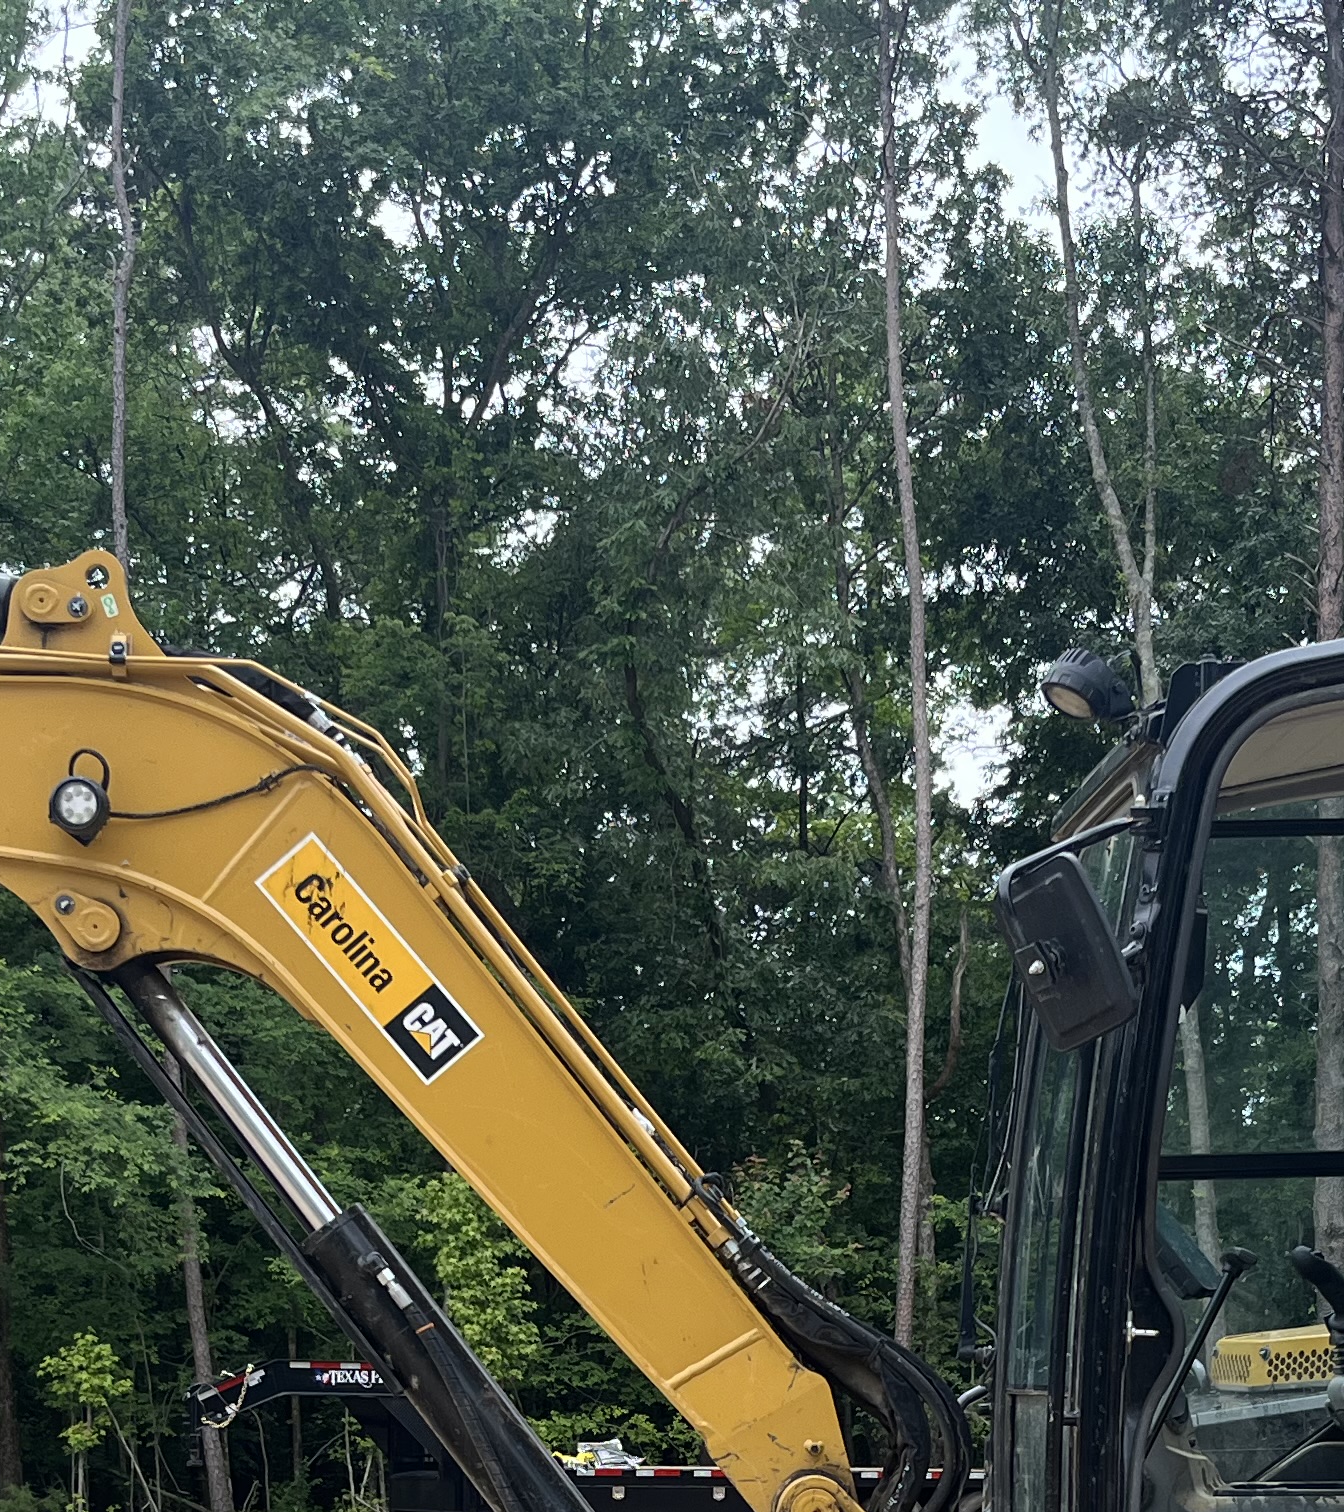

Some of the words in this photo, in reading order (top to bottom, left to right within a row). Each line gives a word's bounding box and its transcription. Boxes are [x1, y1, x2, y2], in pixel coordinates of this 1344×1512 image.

[294, 873, 394, 994] Carolina
[402, 1002, 461, 1061] CAT
[328, 1370, 372, 1388] TEXAS
